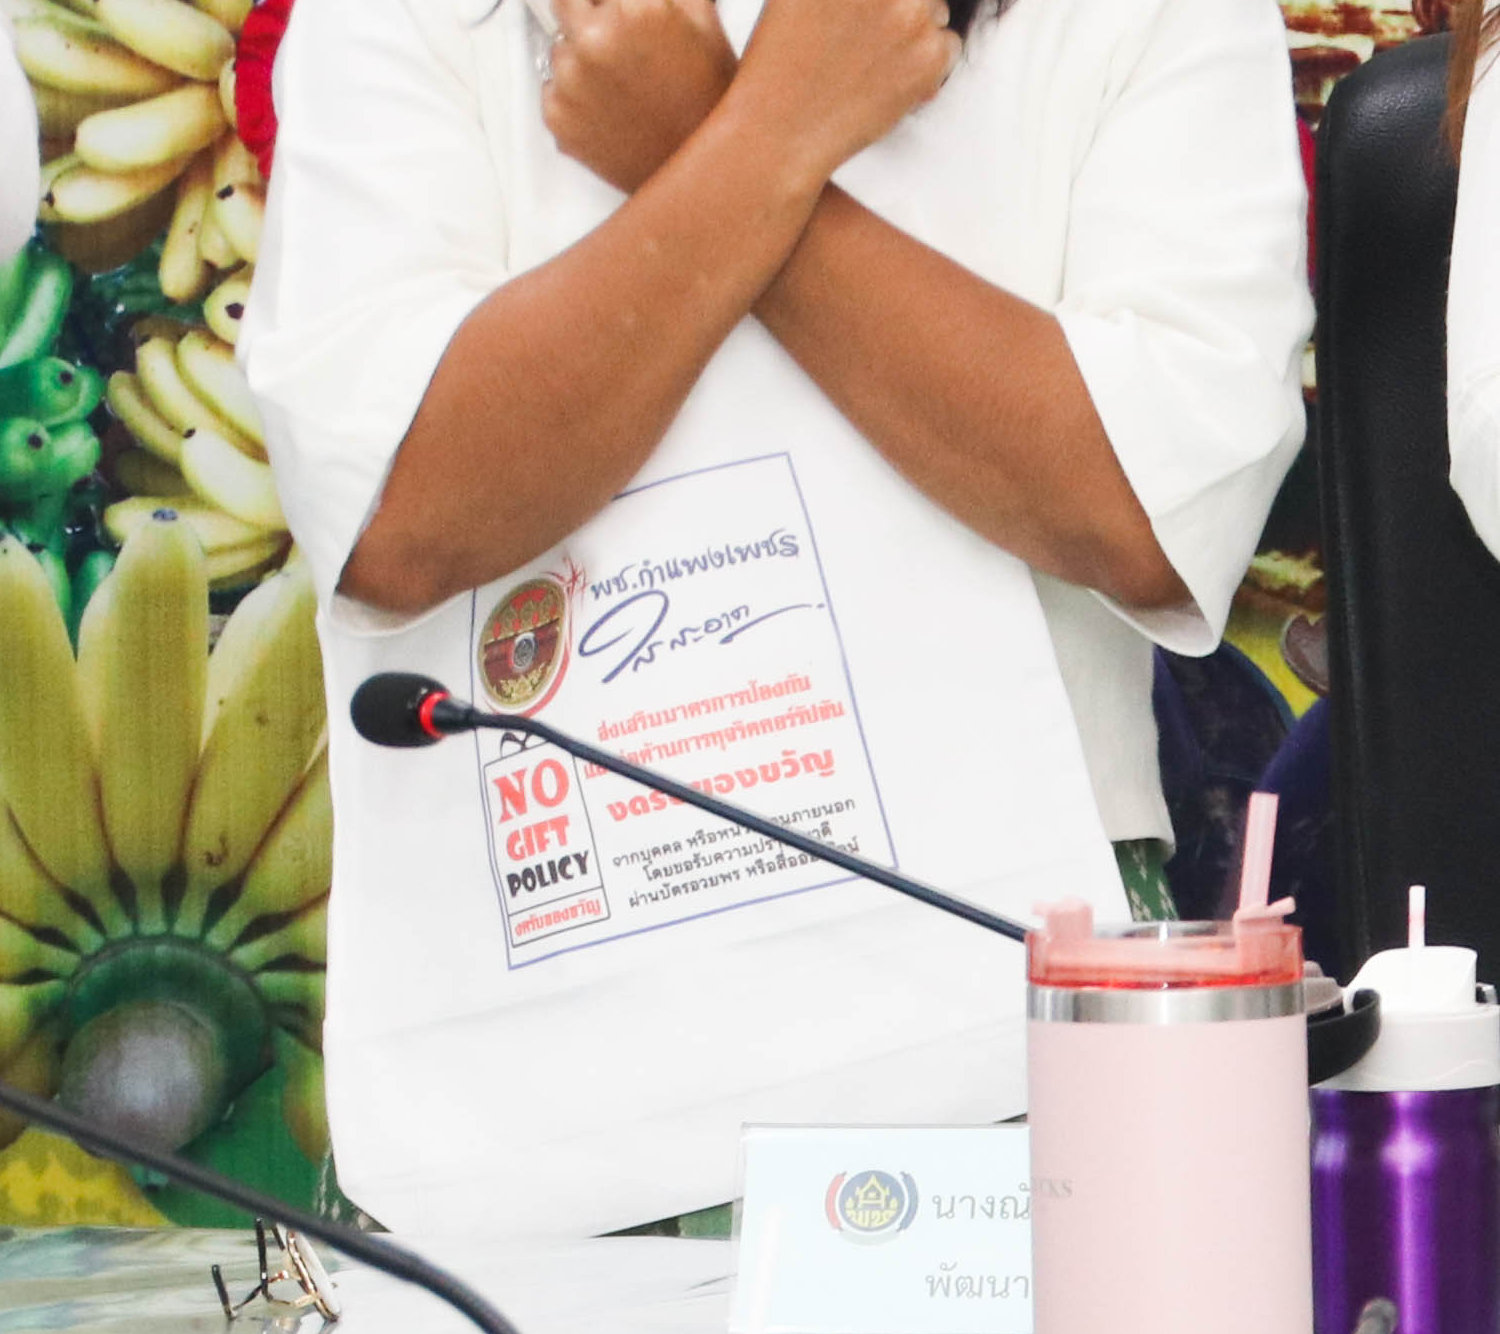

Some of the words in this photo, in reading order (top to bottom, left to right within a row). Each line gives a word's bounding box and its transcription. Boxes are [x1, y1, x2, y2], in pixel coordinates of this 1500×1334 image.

[492, 758, 570, 825] NO
[505, 814, 570, 862] GIFT
[506, 849, 590, 898] POLICY
